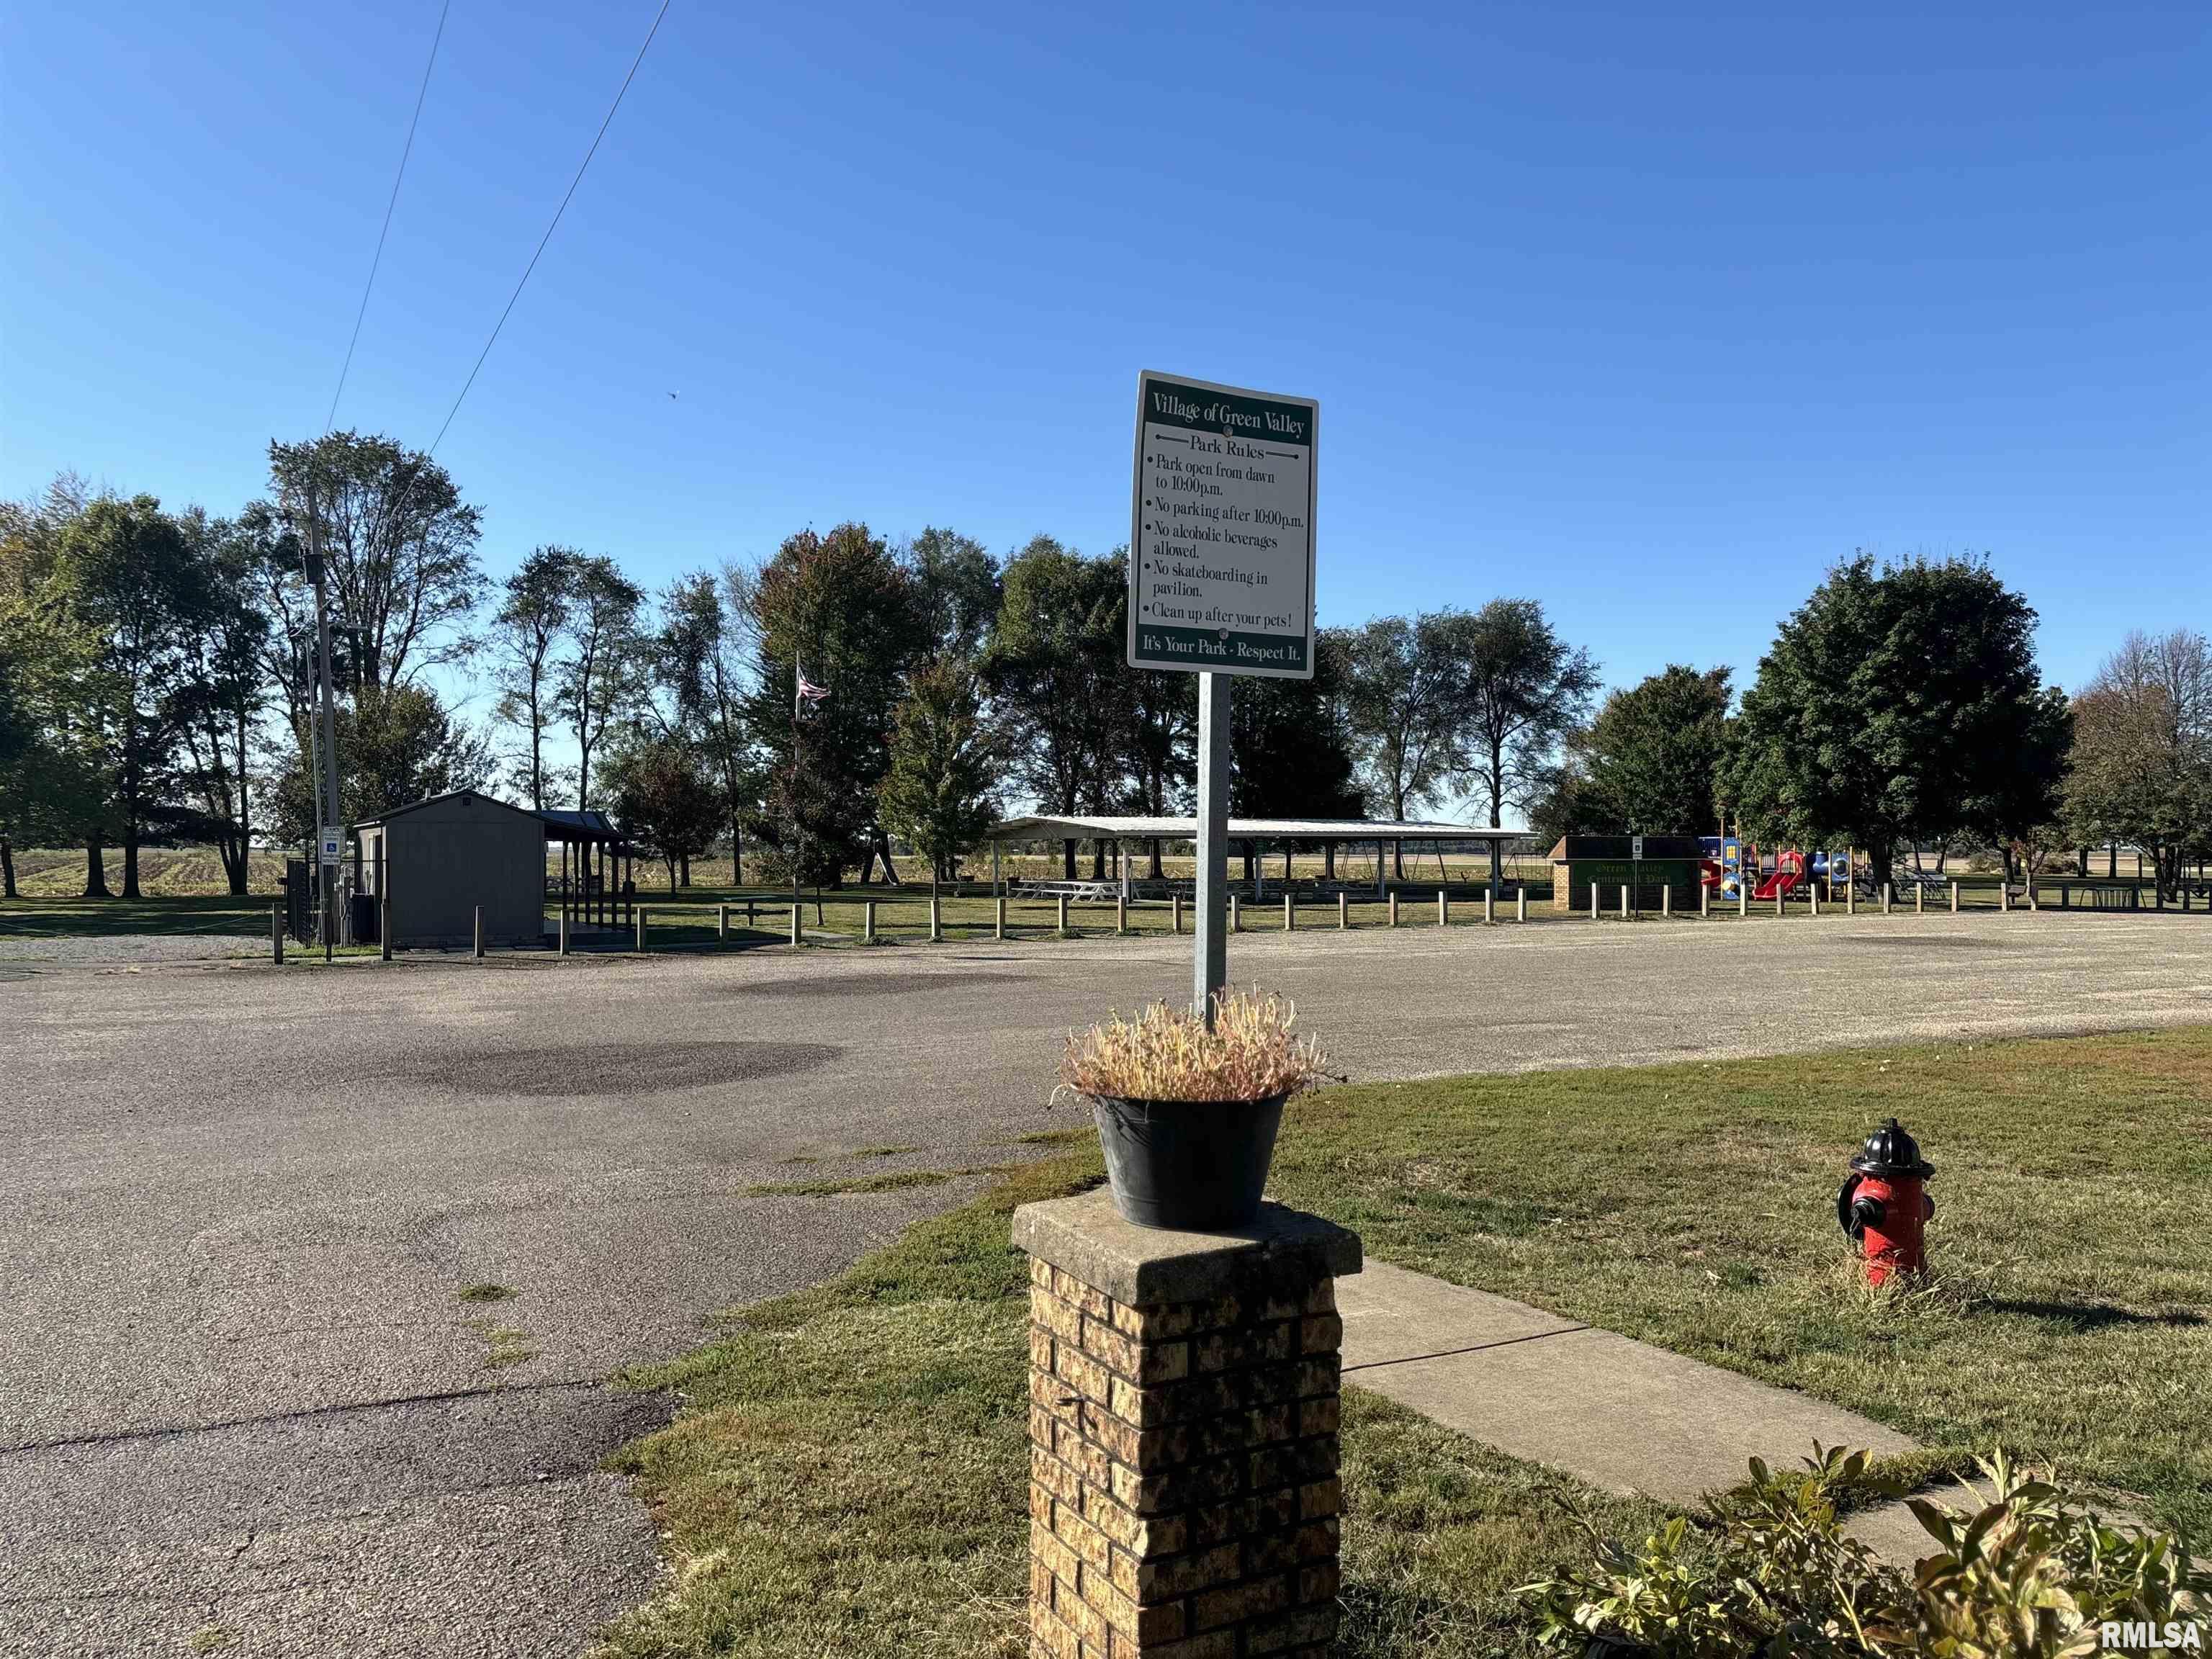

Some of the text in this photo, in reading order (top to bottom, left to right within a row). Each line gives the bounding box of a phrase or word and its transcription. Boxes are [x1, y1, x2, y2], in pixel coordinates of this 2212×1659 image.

[1153, 392, 1304, 439] Village of Green Valley
[1190, 436, 1264, 459] Park Rules
[1156, 454, 1274, 483] Park open from dawn
[1156, 476, 1167, 488] to
[1155, 497, 1169, 512] No
[1174, 501, 1218, 521] parking
[1223, 505, 1250, 521] after
[1154, 521, 1277, 550] No alcoholic beverages
[1154, 541, 1199, 559] allowed.
[1154, 559, 1267, 588] No skateboarding in
[1154, 582, 1202, 598] pavilion.
[1152, 602, 1291, 629] Clean up after your pets!
[1143, 634, 1161, 649] It's
[1164, 636, 1194, 653] Your
[1198, 639, 1226, 655] Park
[1237, 642, 1284, 661] Respect
[1289, 646, 1300, 660] It.
